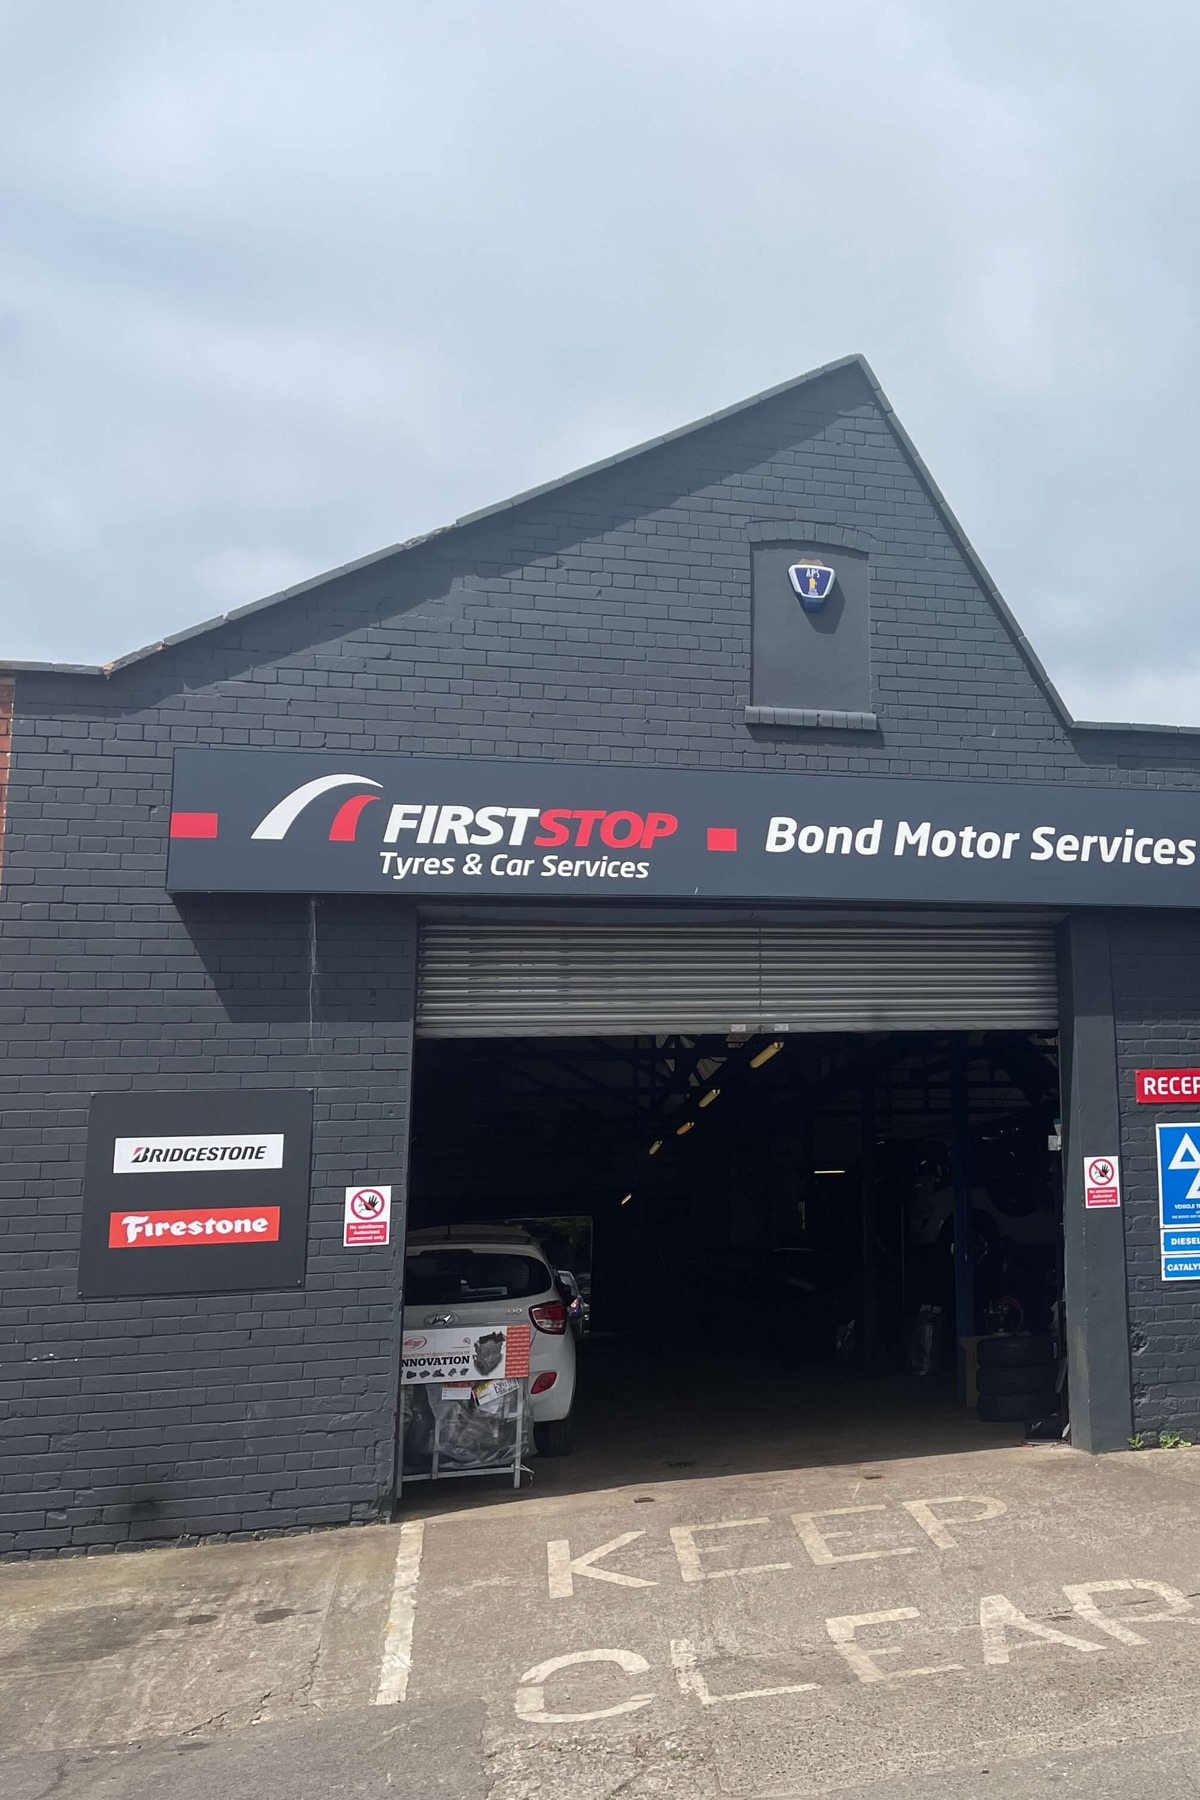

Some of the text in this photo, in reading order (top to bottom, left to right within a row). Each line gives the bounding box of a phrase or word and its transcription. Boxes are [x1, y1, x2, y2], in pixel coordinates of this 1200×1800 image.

[765, 816, 1197, 866] Bond Motor Services
[379, 851, 650, 880] Tyres & Car Services
[131, 1146, 267, 1163] BRIDGESTONE
[121, 1215, 269, 1244] Firestone
[400, 1355, 471, 1368] NNOVATION
[546, 1496, 1008, 1599] KEEP
